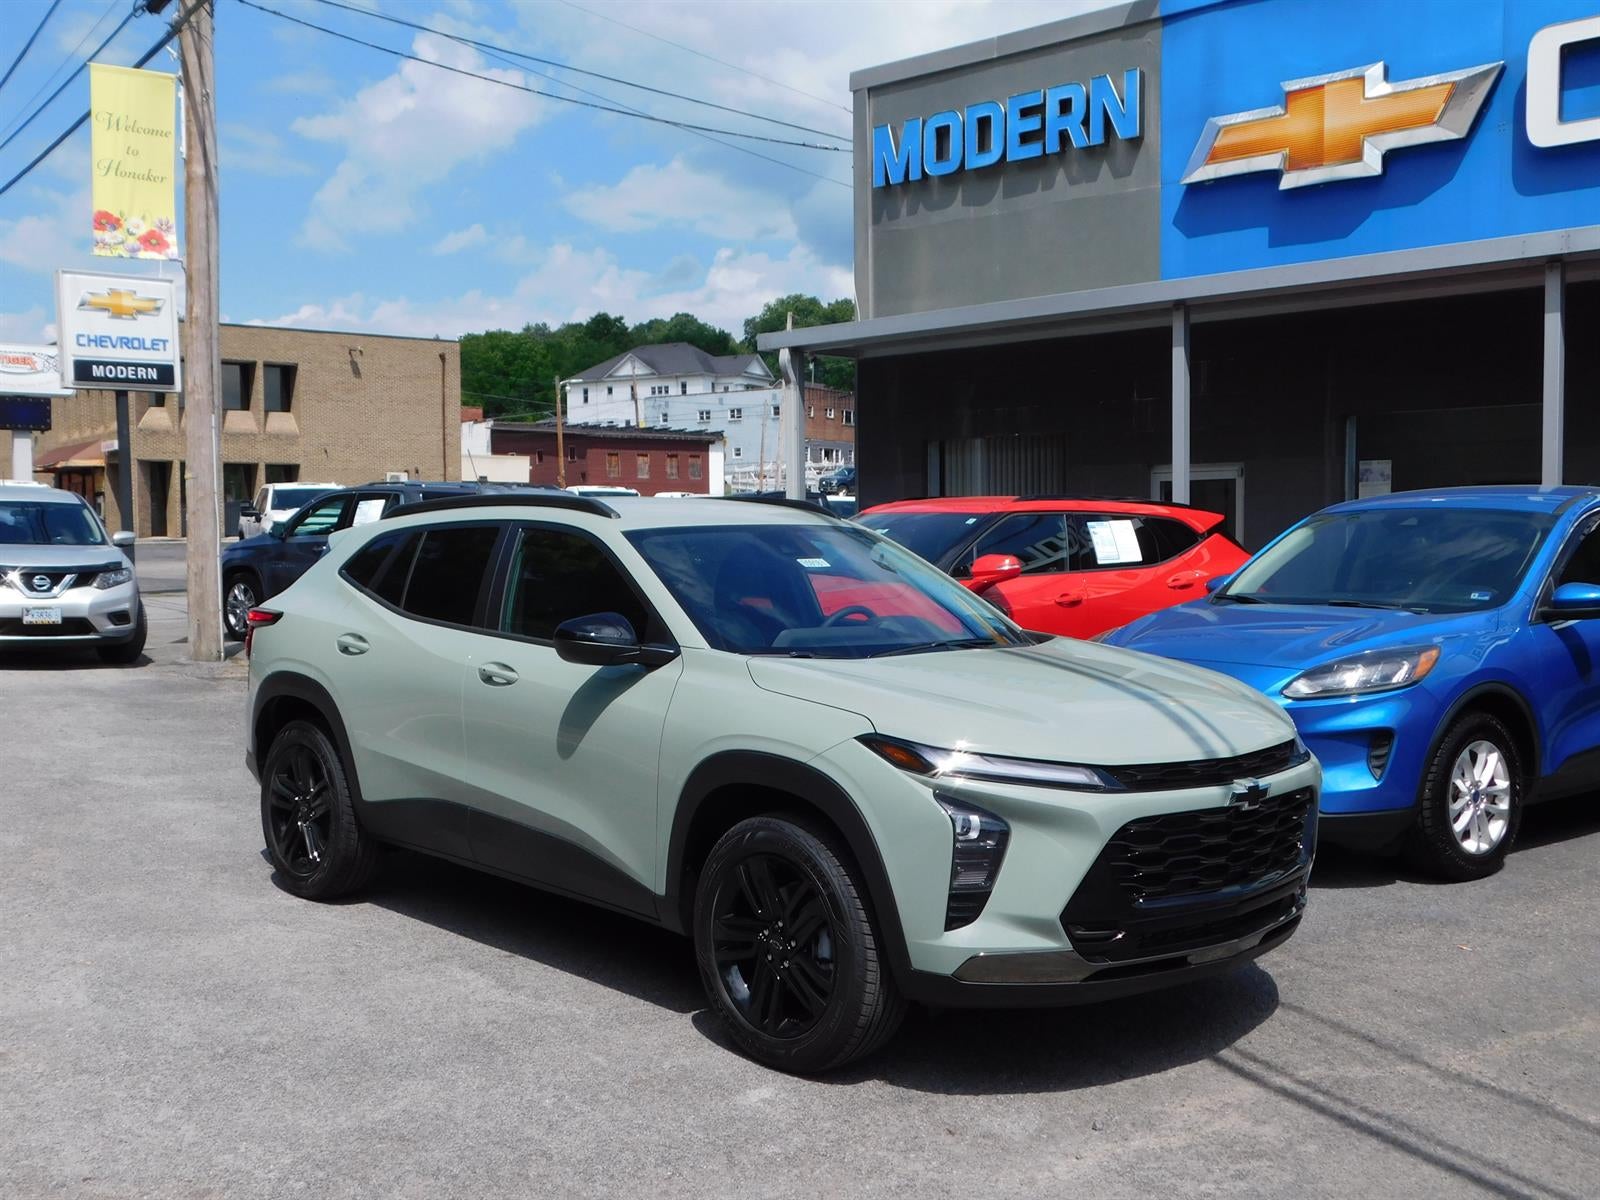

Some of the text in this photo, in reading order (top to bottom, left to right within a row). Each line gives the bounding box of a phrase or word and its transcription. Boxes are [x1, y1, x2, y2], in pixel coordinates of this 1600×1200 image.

[95, 112, 172, 138] Welcome
[872, 67, 1140, 188] MODERN
[126, 146, 139, 157] to
[96, 159, 167, 183] Honaker
[76, 333, 169, 352] CHEVROLET
[92, 364, 158, 380] MODERN
